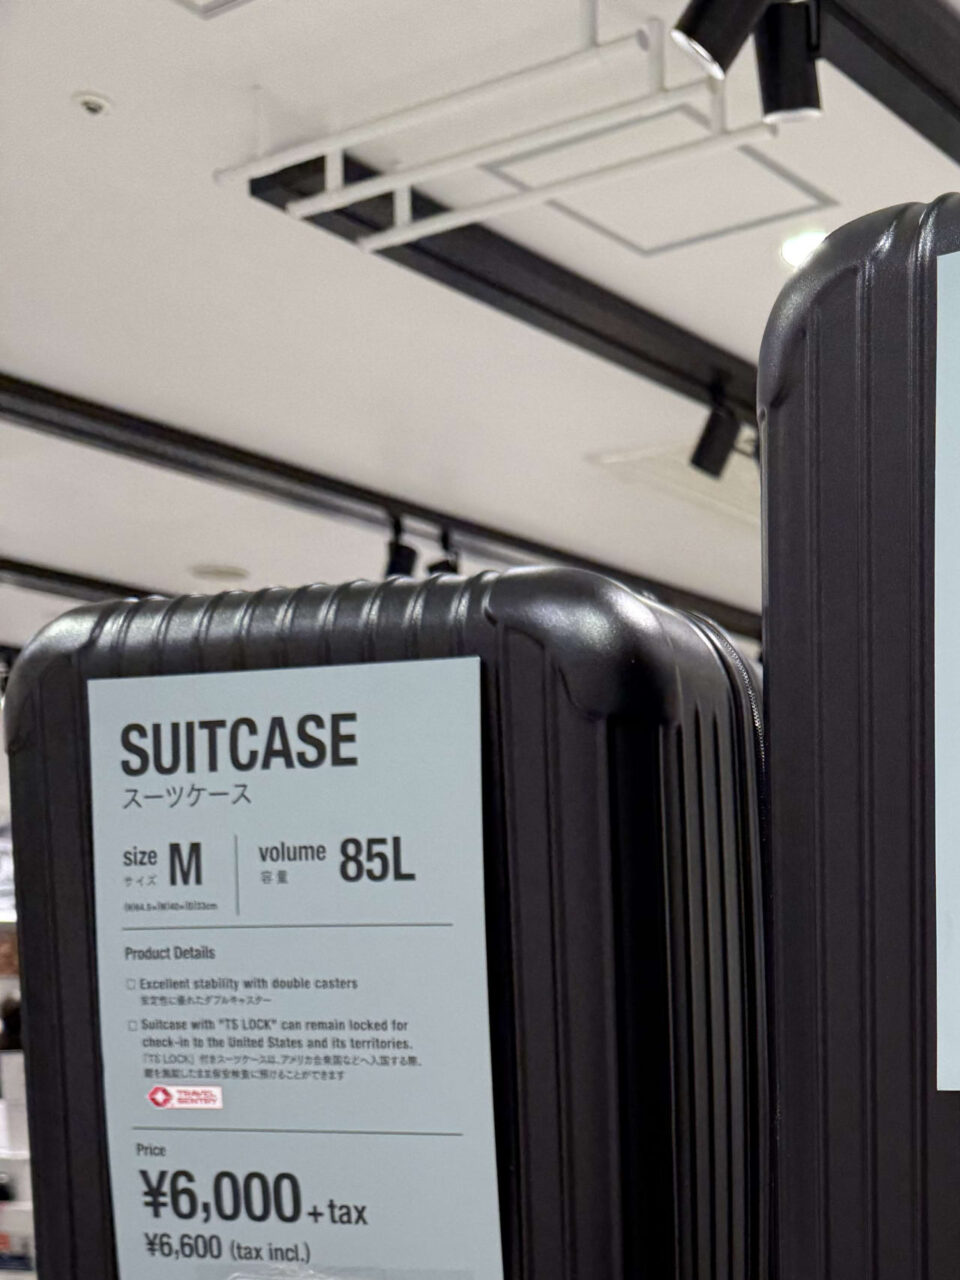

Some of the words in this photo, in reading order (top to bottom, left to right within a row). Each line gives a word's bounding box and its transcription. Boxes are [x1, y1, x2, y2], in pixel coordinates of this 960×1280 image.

[120, 712, 358, 777] SUITCASE
[123, 783, 252, 809] スーツケース
[123, 846, 158, 866] size
[168, 841, 203, 886] M
[258, 841, 327, 863] volume
[339, 836, 416, 882] 85L
[125, 947, 171, 960] Product
[174, 946, 216, 960] Details
[139, 978, 190, 990] Excellent
[193, 978, 239, 991] stability
[243, 978, 268, 989] with
[272, 978, 311, 989] double
[314, 978, 358, 989] casters
[141, 1019, 187, 1031] Suitcase
[190, 1019, 215, 1031] with
[281, 1021, 302, 1031] can
[305, 1020, 345, 1031] remain
[349, 1019, 388, 1031] locked
[391, 1019, 408, 1031] for
[142, 1036, 190, 1048] check-in
[193, 1037, 204, 1048] to
[207, 1036, 225, 1048] the
[228, 1036, 264, 1049] United
[267, 1036, 303, 1049] States
[306, 1037, 328, 1049] and
[331, 1037, 347, 1049] its
[350, 1037, 413, 1050] territories.
[136, 1143, 166, 1157] Price
[139, 1169, 302, 1223] ¥6,000
[144, 1232, 222, 1259] ¥6,600
[230, 1240, 263, 1261] (tax
[269, 1242, 311, 1264] incl.)
